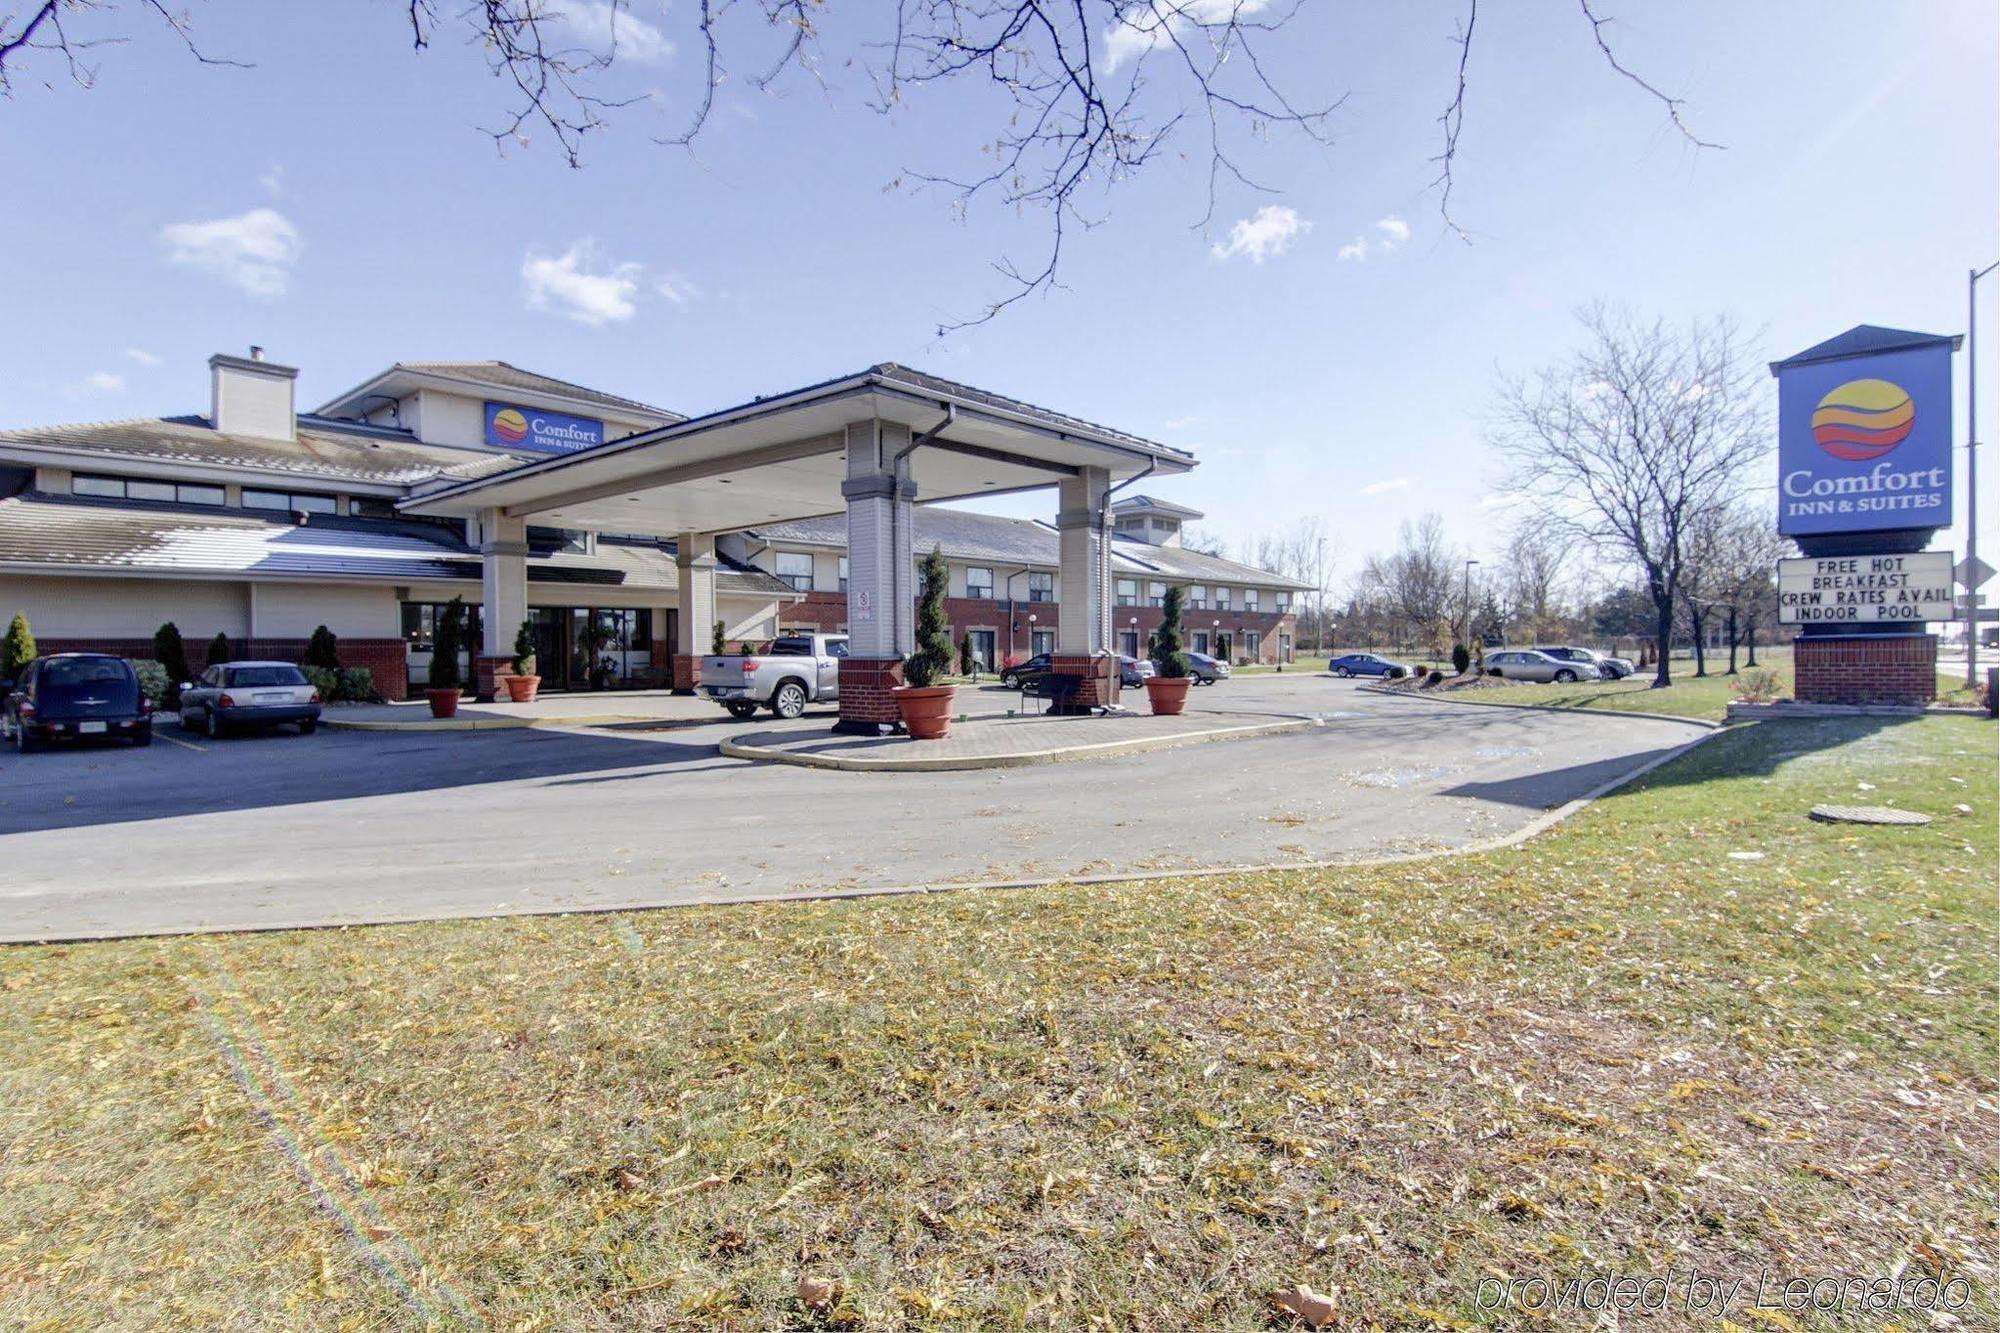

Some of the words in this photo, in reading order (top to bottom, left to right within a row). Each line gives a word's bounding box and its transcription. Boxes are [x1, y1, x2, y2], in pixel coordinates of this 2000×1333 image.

[531, 419, 597, 442] Comfort
[534, 435, 555, 446] INN
[555, 439, 562, 447] &
[1783, 462, 1945, 497] Comfort
[1788, 502, 1834, 516] INN
[1838, 500, 1854, 513] &
[1857, 493, 1942, 511] SUITES
[1817, 560, 1858, 573] FREE
[1872, 558, 1905, 571] HOT
[1813, 574, 1910, 590] BREAKFAST
[1781, 593, 1821, 606] CREW
[1837, 591, 1886, 604] RATES
[1898, 589, 1950, 602] AVAIL
[1795, 607, 1857, 620] INDOOR
[1877, 606, 1922, 619] POOL
